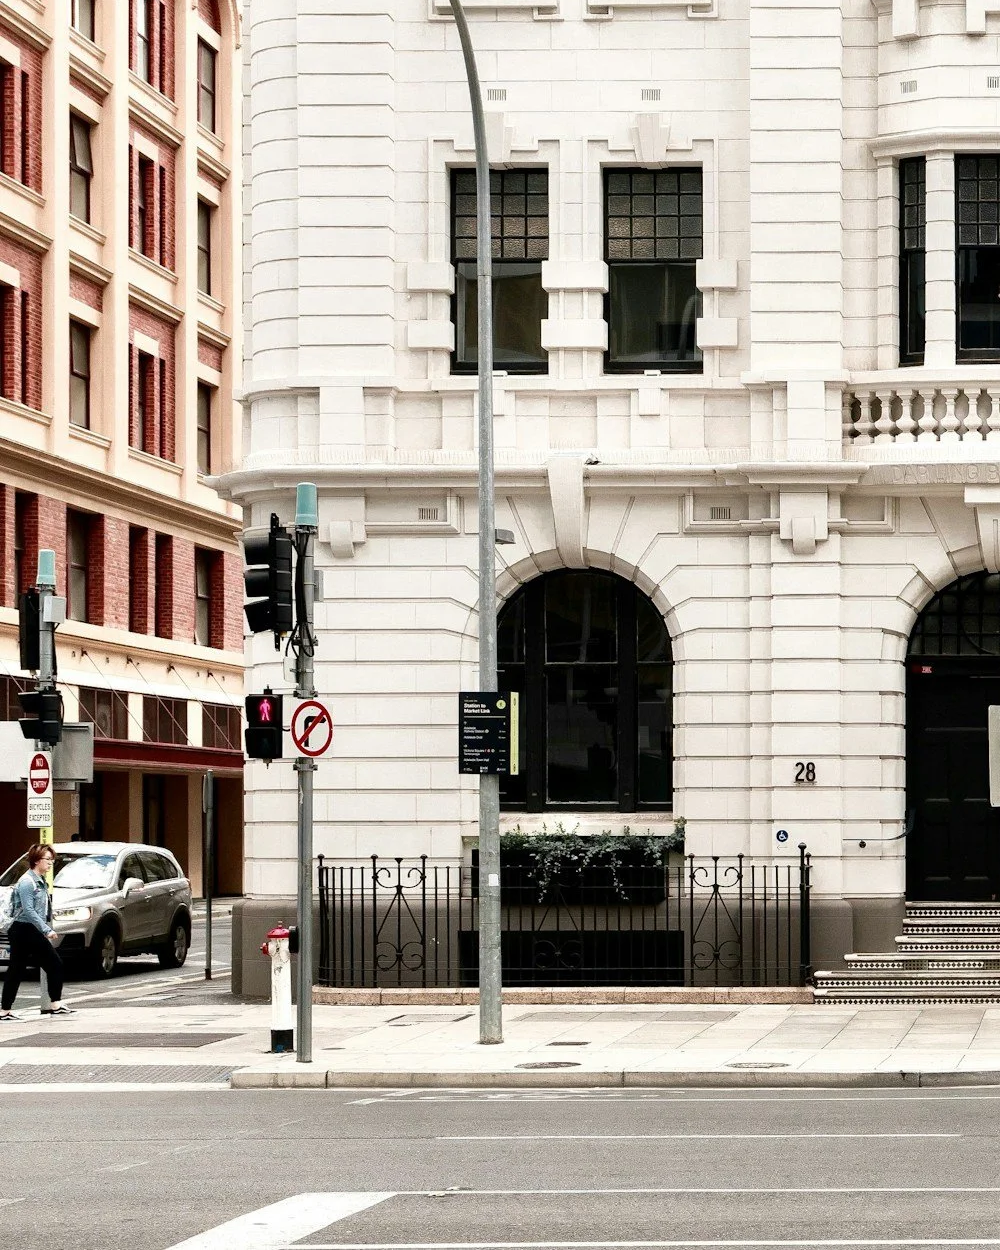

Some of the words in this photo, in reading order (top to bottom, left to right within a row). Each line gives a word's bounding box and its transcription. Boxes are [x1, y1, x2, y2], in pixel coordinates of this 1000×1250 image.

[892, 464, 978, 484] DARLING
[35, 758, 44, 767] NO
[795, 762, 816, 782] 28
[29, 803, 51, 811] BICYCLES
[29, 814, 51, 822] EXCEPTED
